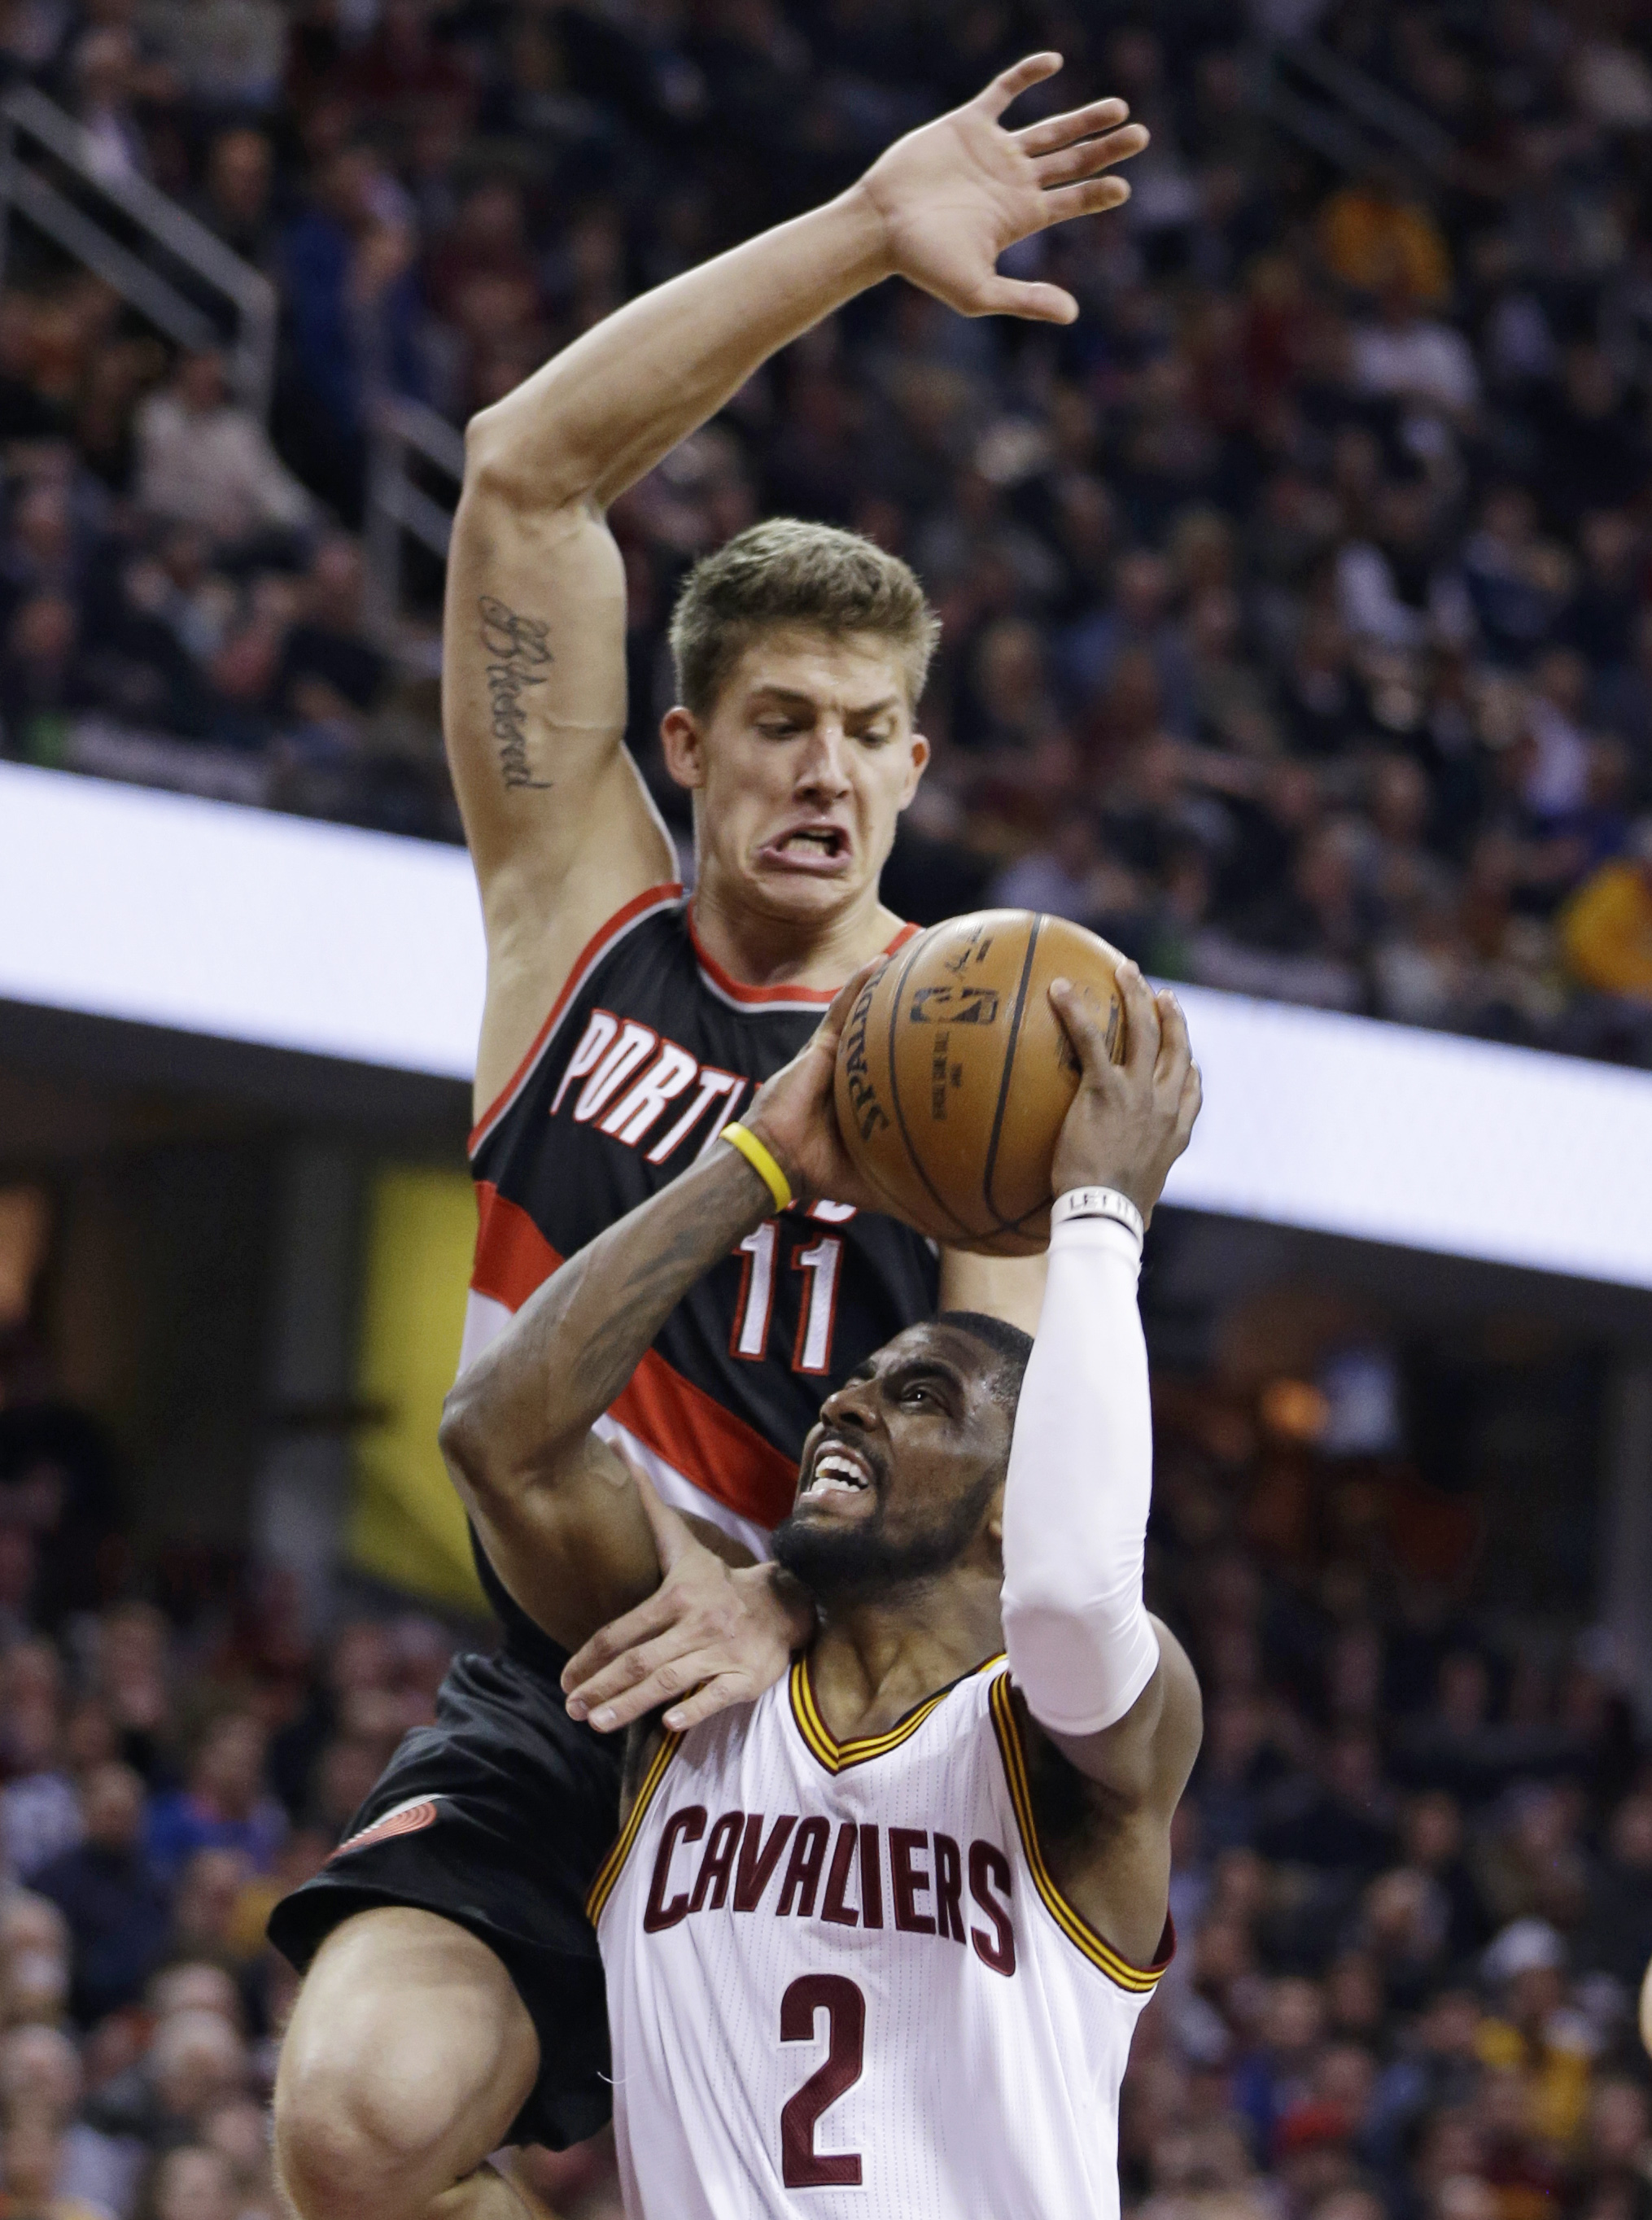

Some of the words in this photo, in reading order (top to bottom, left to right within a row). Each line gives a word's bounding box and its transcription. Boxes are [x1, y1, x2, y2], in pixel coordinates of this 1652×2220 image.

[845, 953, 898, 1142] SPALDI
[730, 1219, 844, 1376] 11
[643, 1804, 1016, 1977] CAVALIERS
[779, 1973, 867, 2189] 2
